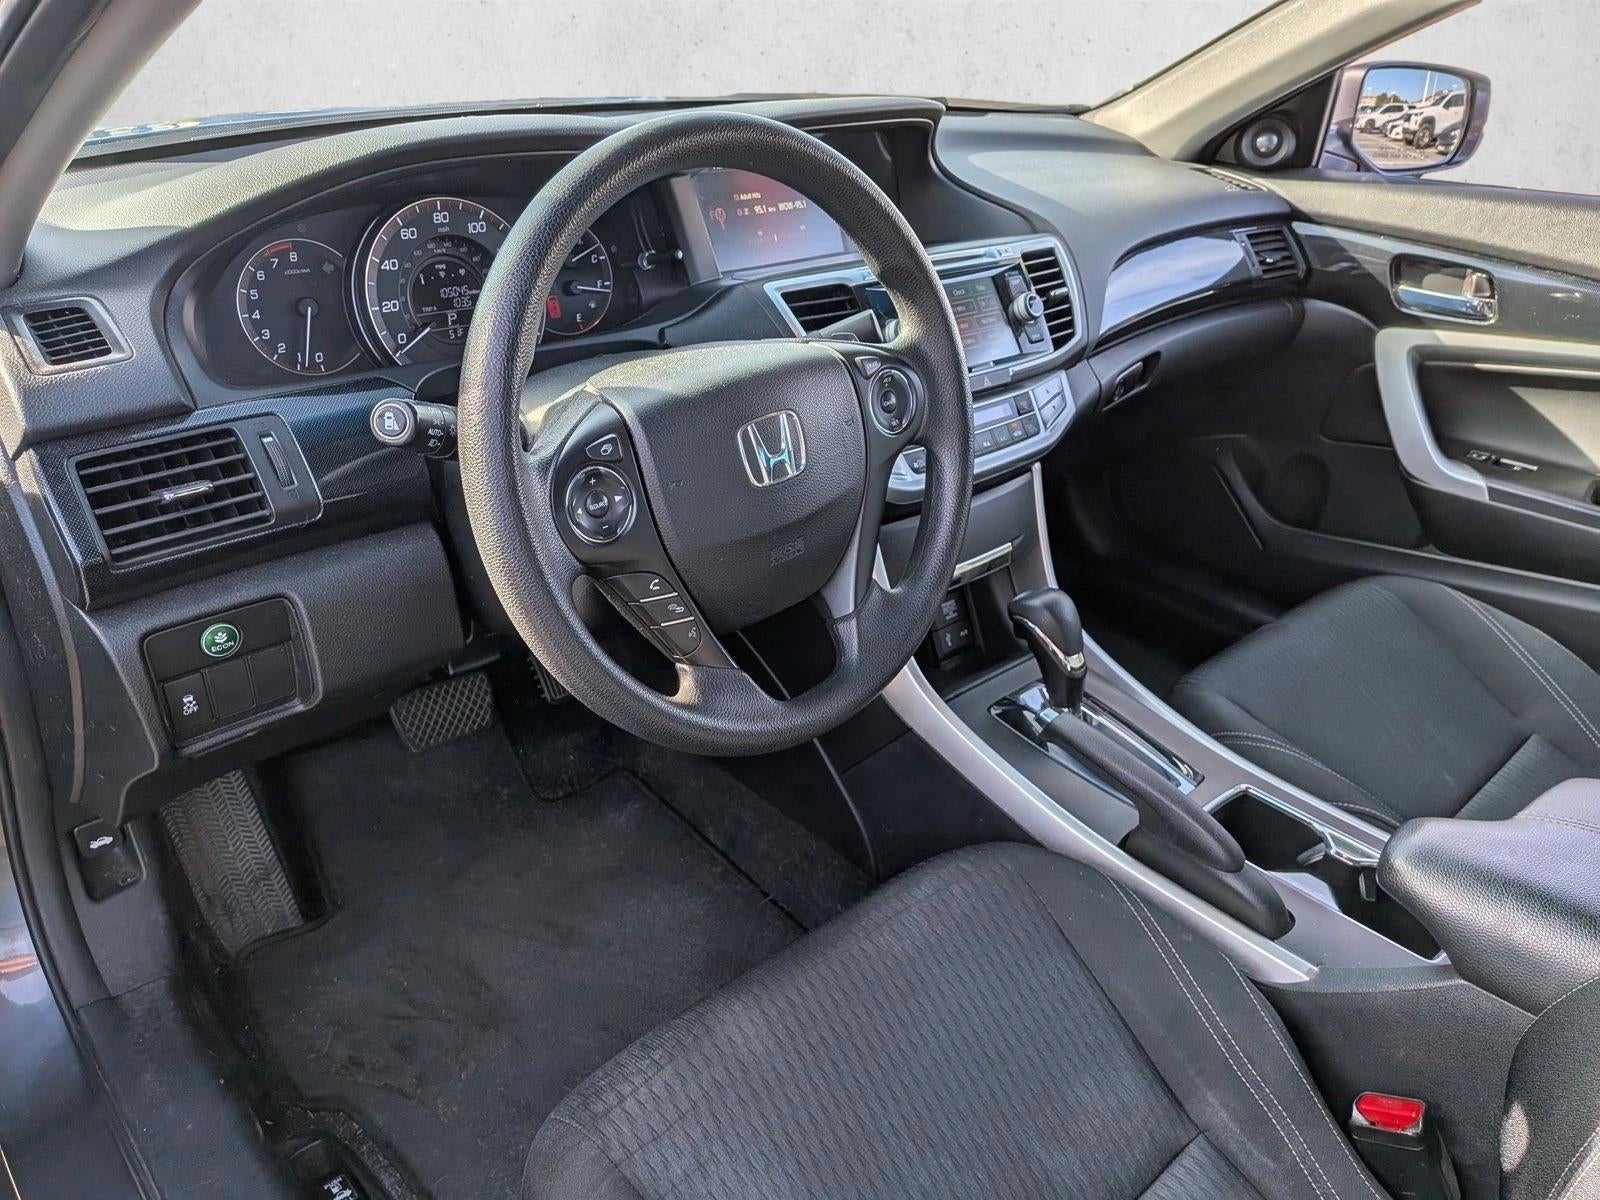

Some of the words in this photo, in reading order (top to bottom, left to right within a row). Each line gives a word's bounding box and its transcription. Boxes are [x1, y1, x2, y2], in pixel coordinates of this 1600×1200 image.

[432, 212, 449, 223] 80
[467, 221, 487, 234] 100
[400, 228, 418, 240] 60
[289, 252, 298, 262] 8
[591, 254, 598, 264] C
[270, 258, 279, 269] 7
[380, 259, 399, 271] 40
[256, 270, 266, 281] 6
[597, 280, 603, 289] F
[249, 289, 259, 300] 5
[381, 300, 399, 313] 20
[251, 309, 261, 320] 4
[447, 312, 457, 326] P
[576, 313, 583, 322] E
[261, 329, 271, 340] 3
[397, 333, 407, 344] 0
[277, 343, 287, 353] 2
[315, 352, 324, 363] 0
[589, 500, 609, 511] SOURCE
[211, 641, 235, 652] ECON
[183, 705, 198, 715] OFF
